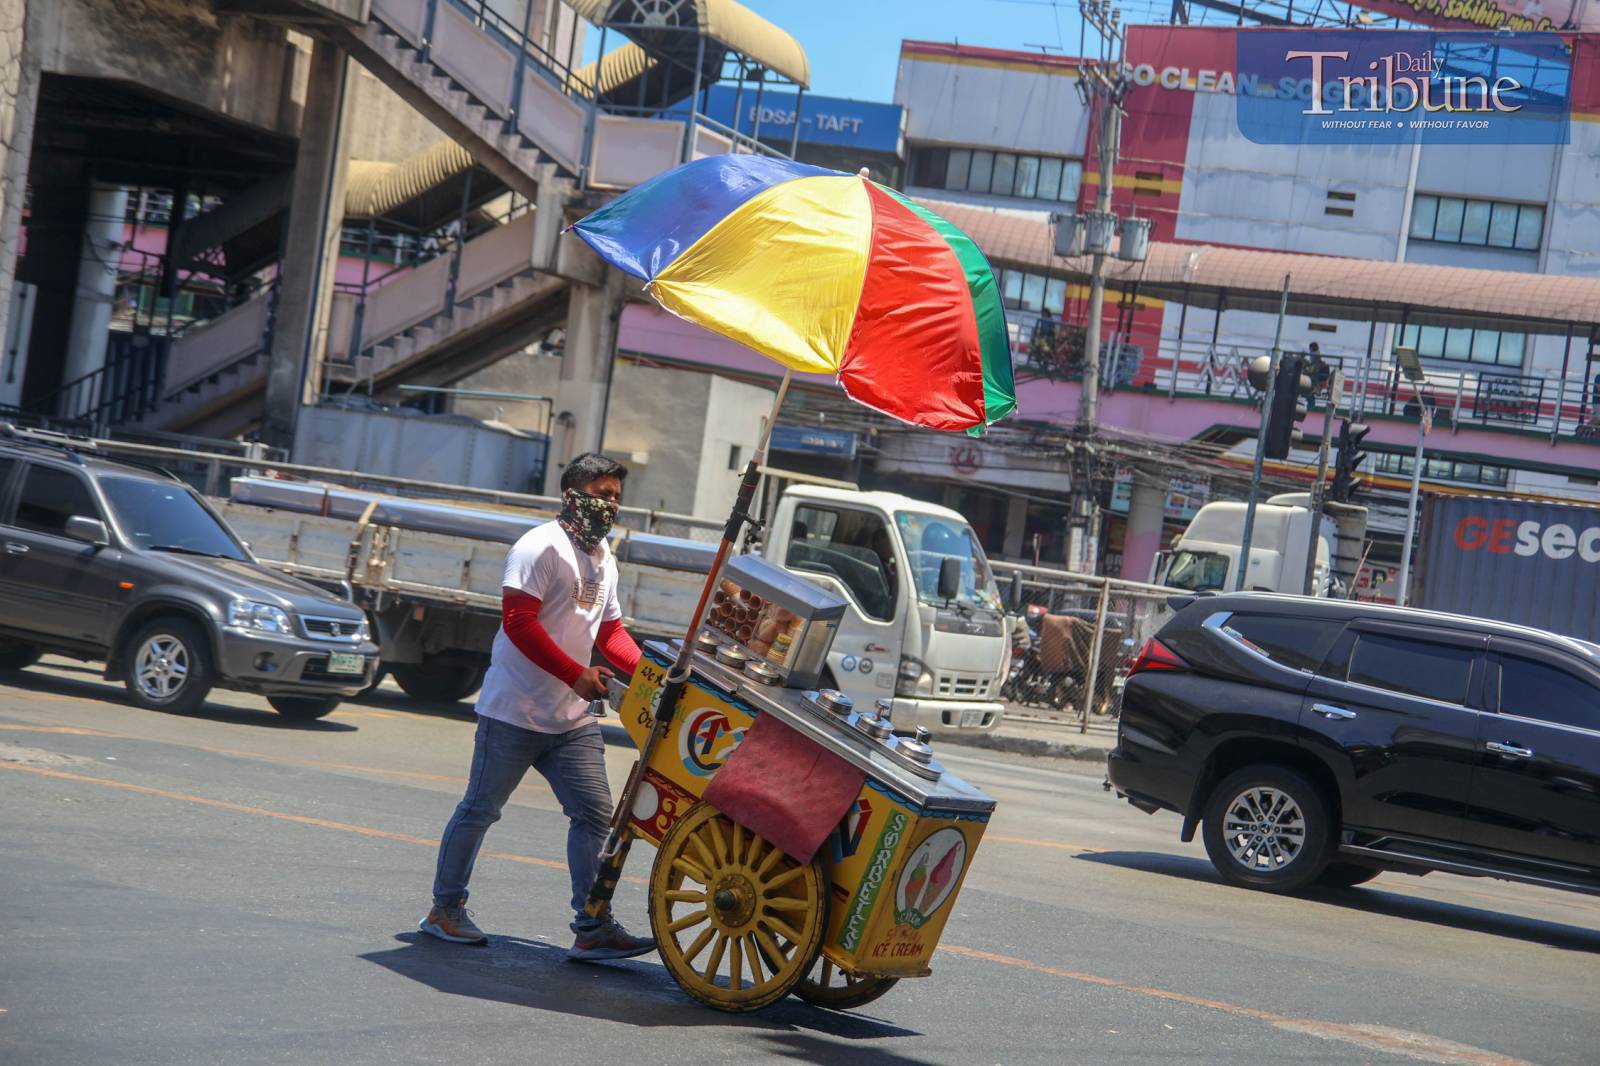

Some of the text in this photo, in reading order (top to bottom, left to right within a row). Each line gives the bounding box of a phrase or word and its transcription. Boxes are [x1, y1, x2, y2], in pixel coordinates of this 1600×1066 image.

[1115, 62, 1156, 86] SO
[749, 106, 798, 125] EDSA
[816, 113, 863, 133] TAFT
[843, 814, 905, 950] SORBETES
[891, 943, 924, 957] CREAM
